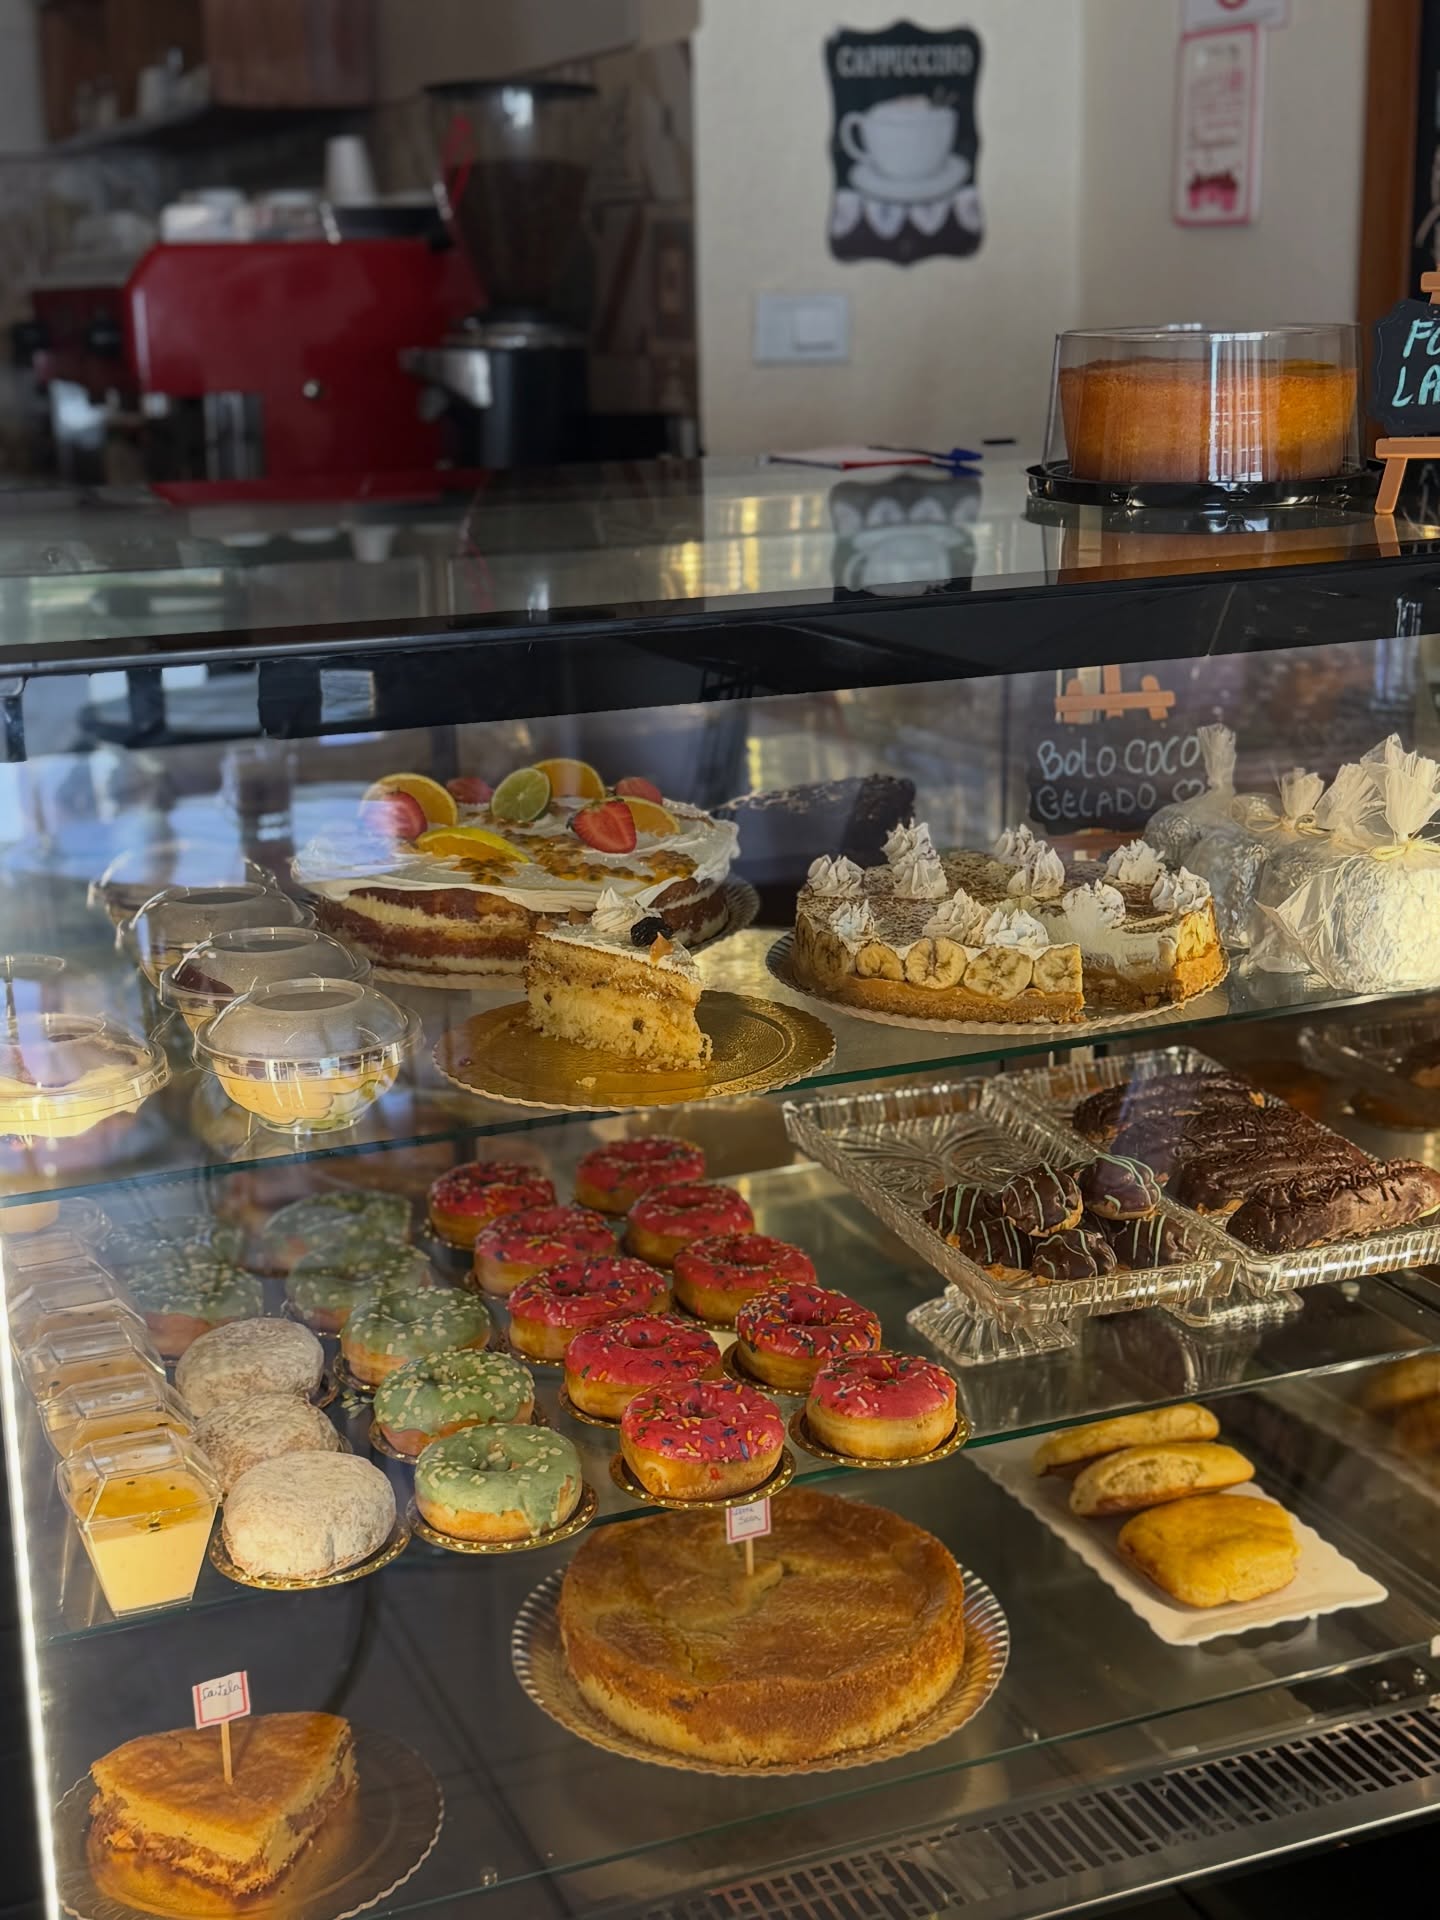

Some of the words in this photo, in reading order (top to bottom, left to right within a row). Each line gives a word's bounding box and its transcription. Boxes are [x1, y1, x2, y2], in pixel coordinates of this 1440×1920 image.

[837, 45, 974, 77] CAPPUCCINO
[1124, 735, 1201, 776] COCO
[1037, 783, 1156, 820] GELADO
